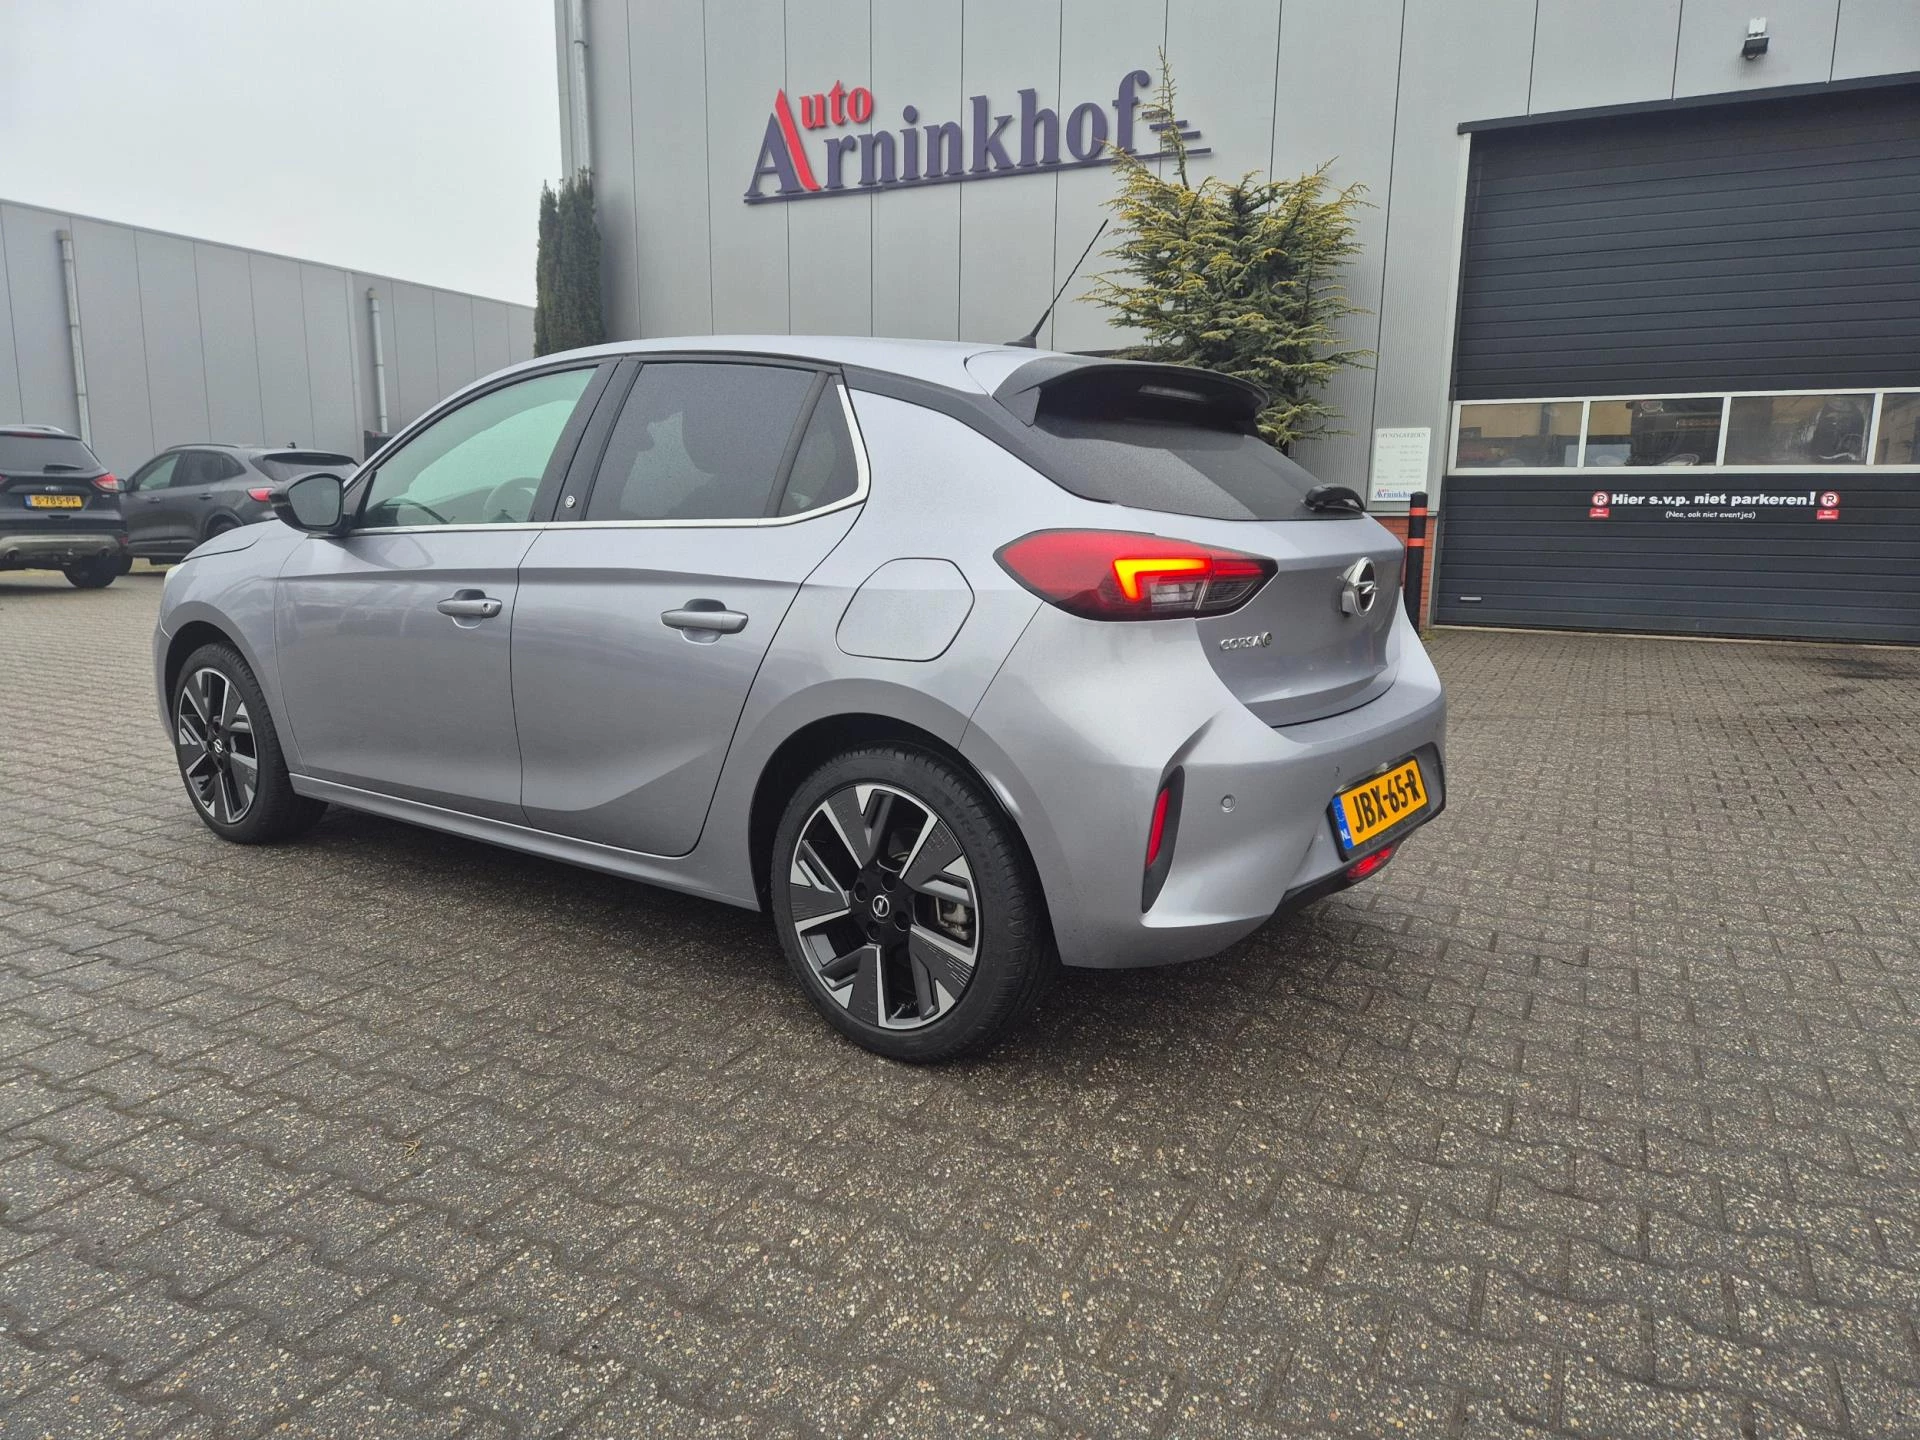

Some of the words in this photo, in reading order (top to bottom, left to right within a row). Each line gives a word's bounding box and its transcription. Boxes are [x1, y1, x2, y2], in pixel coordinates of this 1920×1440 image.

[743, 69, 1150, 198] Arninkhof
[1374, 490, 1414, 499] Arninkho
[1611, 493, 1645, 505] Hier
[1649, 495, 1690, 506] s.v.p.
[1694, 493, 1727, 504] niet
[1731, 491, 1816, 506] parkeren!
[1665, 510, 1686, 519] (Nee,
[1719, 511, 1756, 520] eventjes)
[1352, 768, 1421, 833] JBX-65-R
